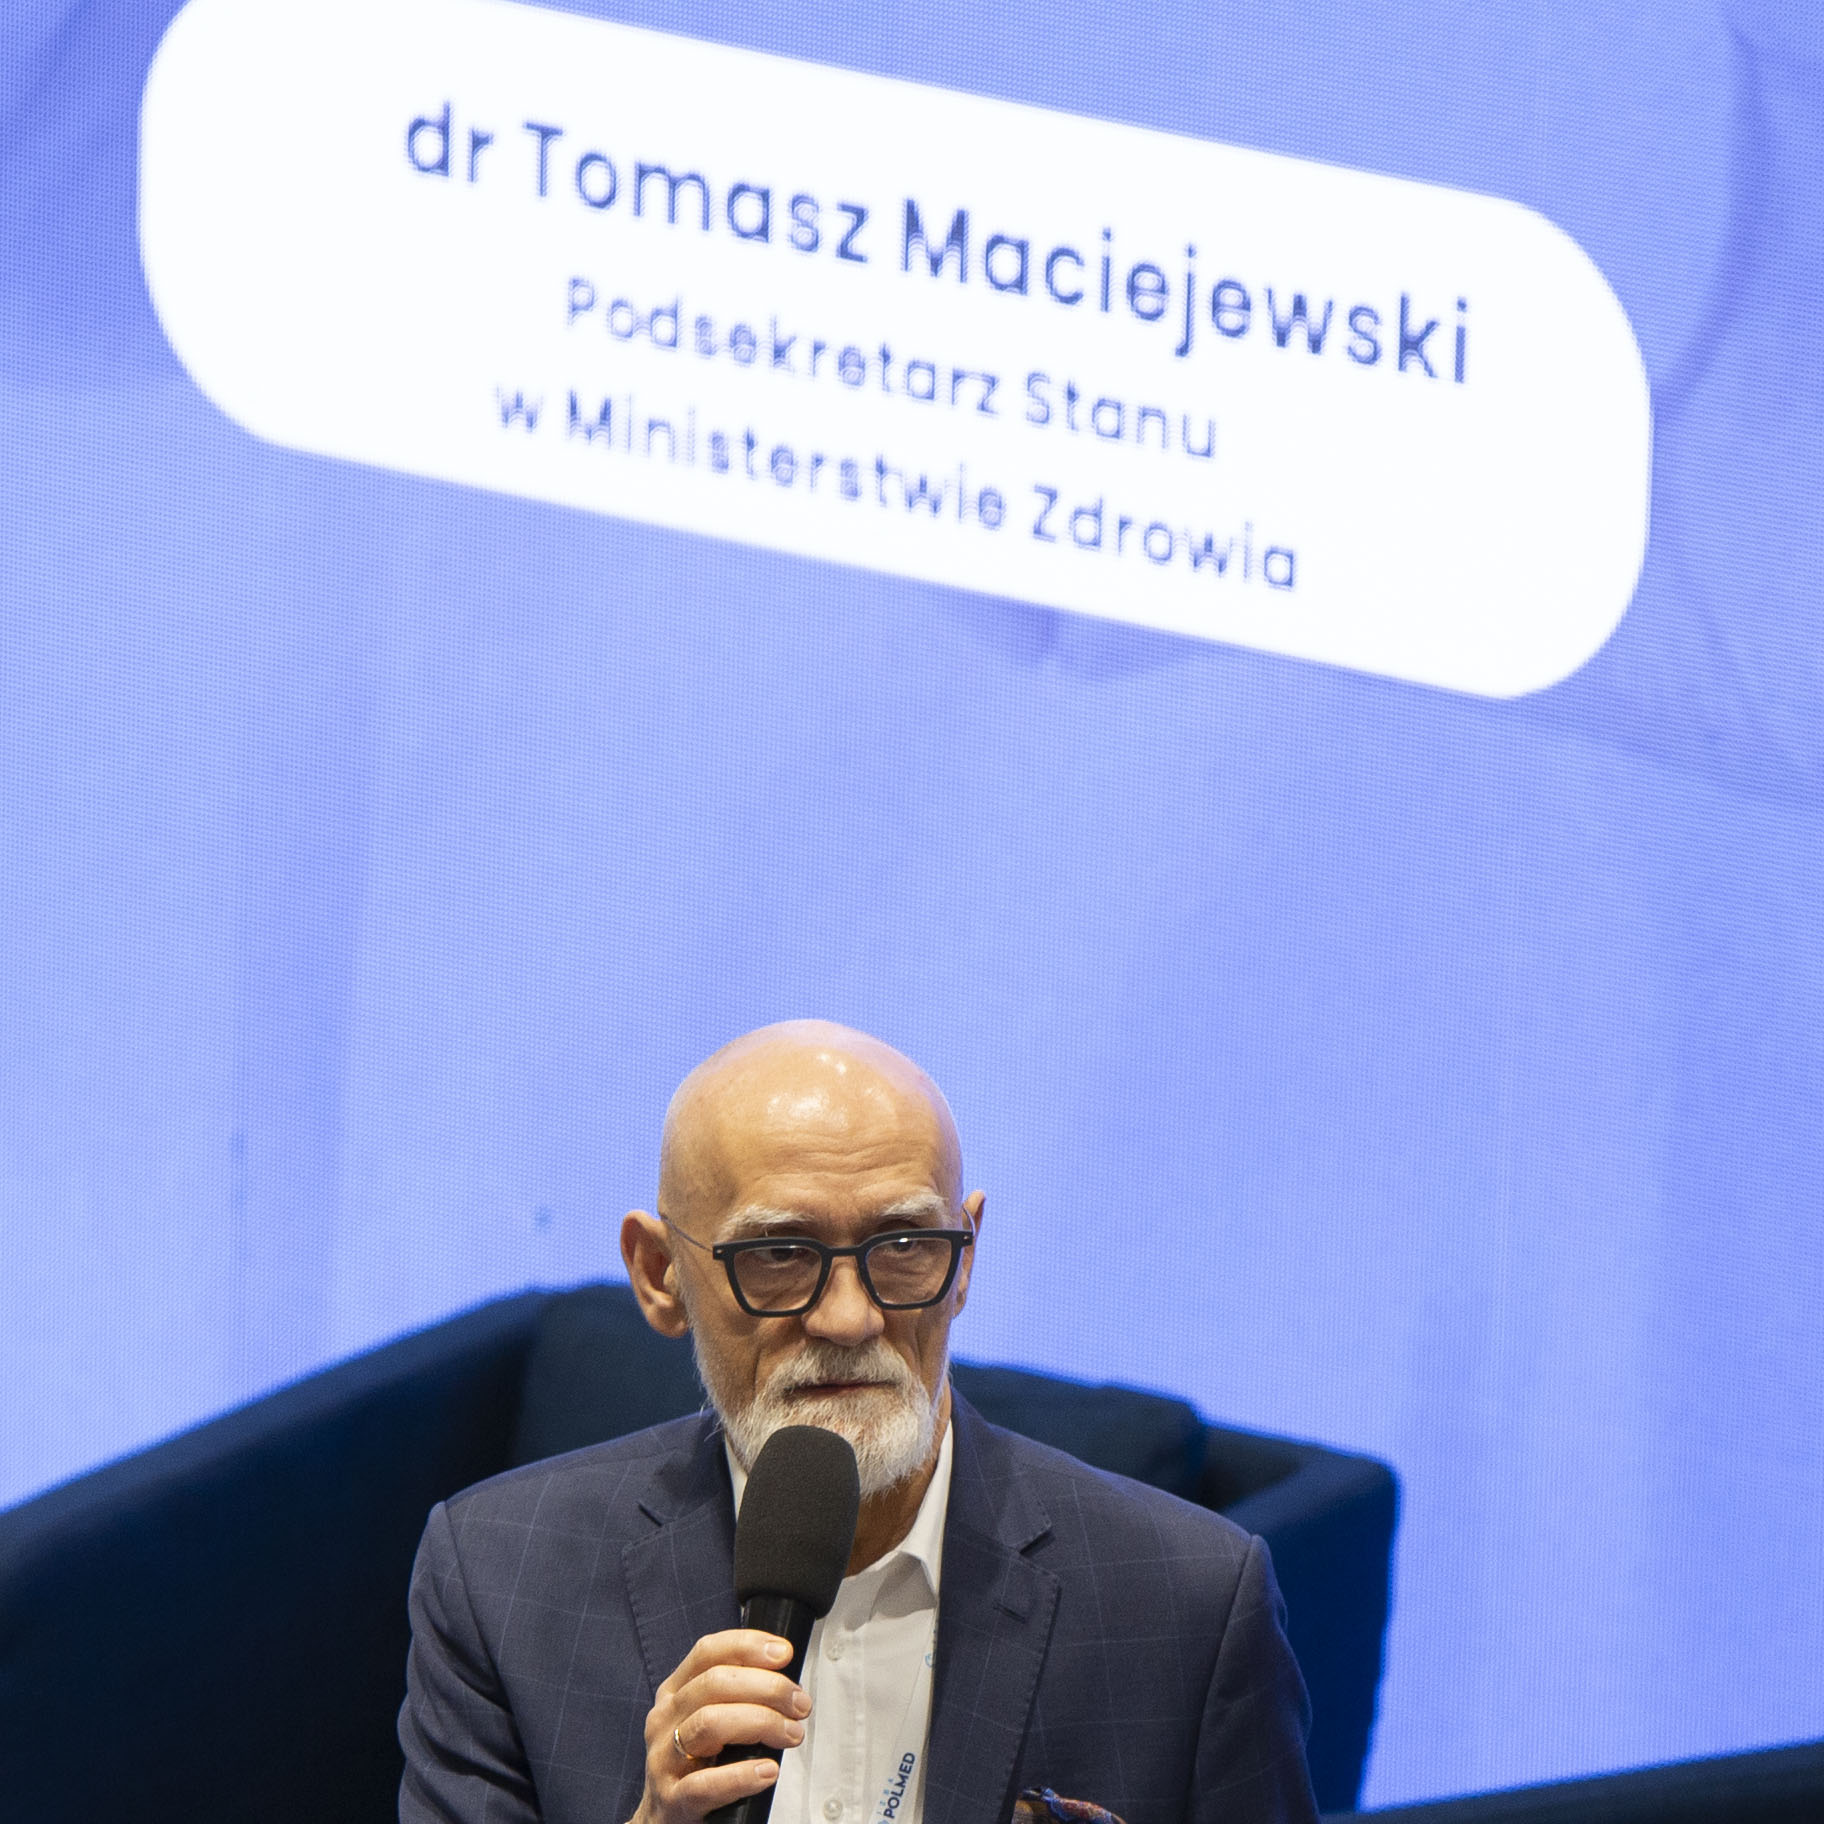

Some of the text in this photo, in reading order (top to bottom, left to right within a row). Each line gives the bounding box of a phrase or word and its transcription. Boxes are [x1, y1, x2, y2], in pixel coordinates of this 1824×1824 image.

[404, 101, 1470, 385] dr Tomasz Maciejewski
[567, 276, 1215, 460] Podsekretarz Stanu
[494, 386, 1298, 588] w Ministerstwie Zdrowia
[883, 1752, 916, 1819] POLMED
